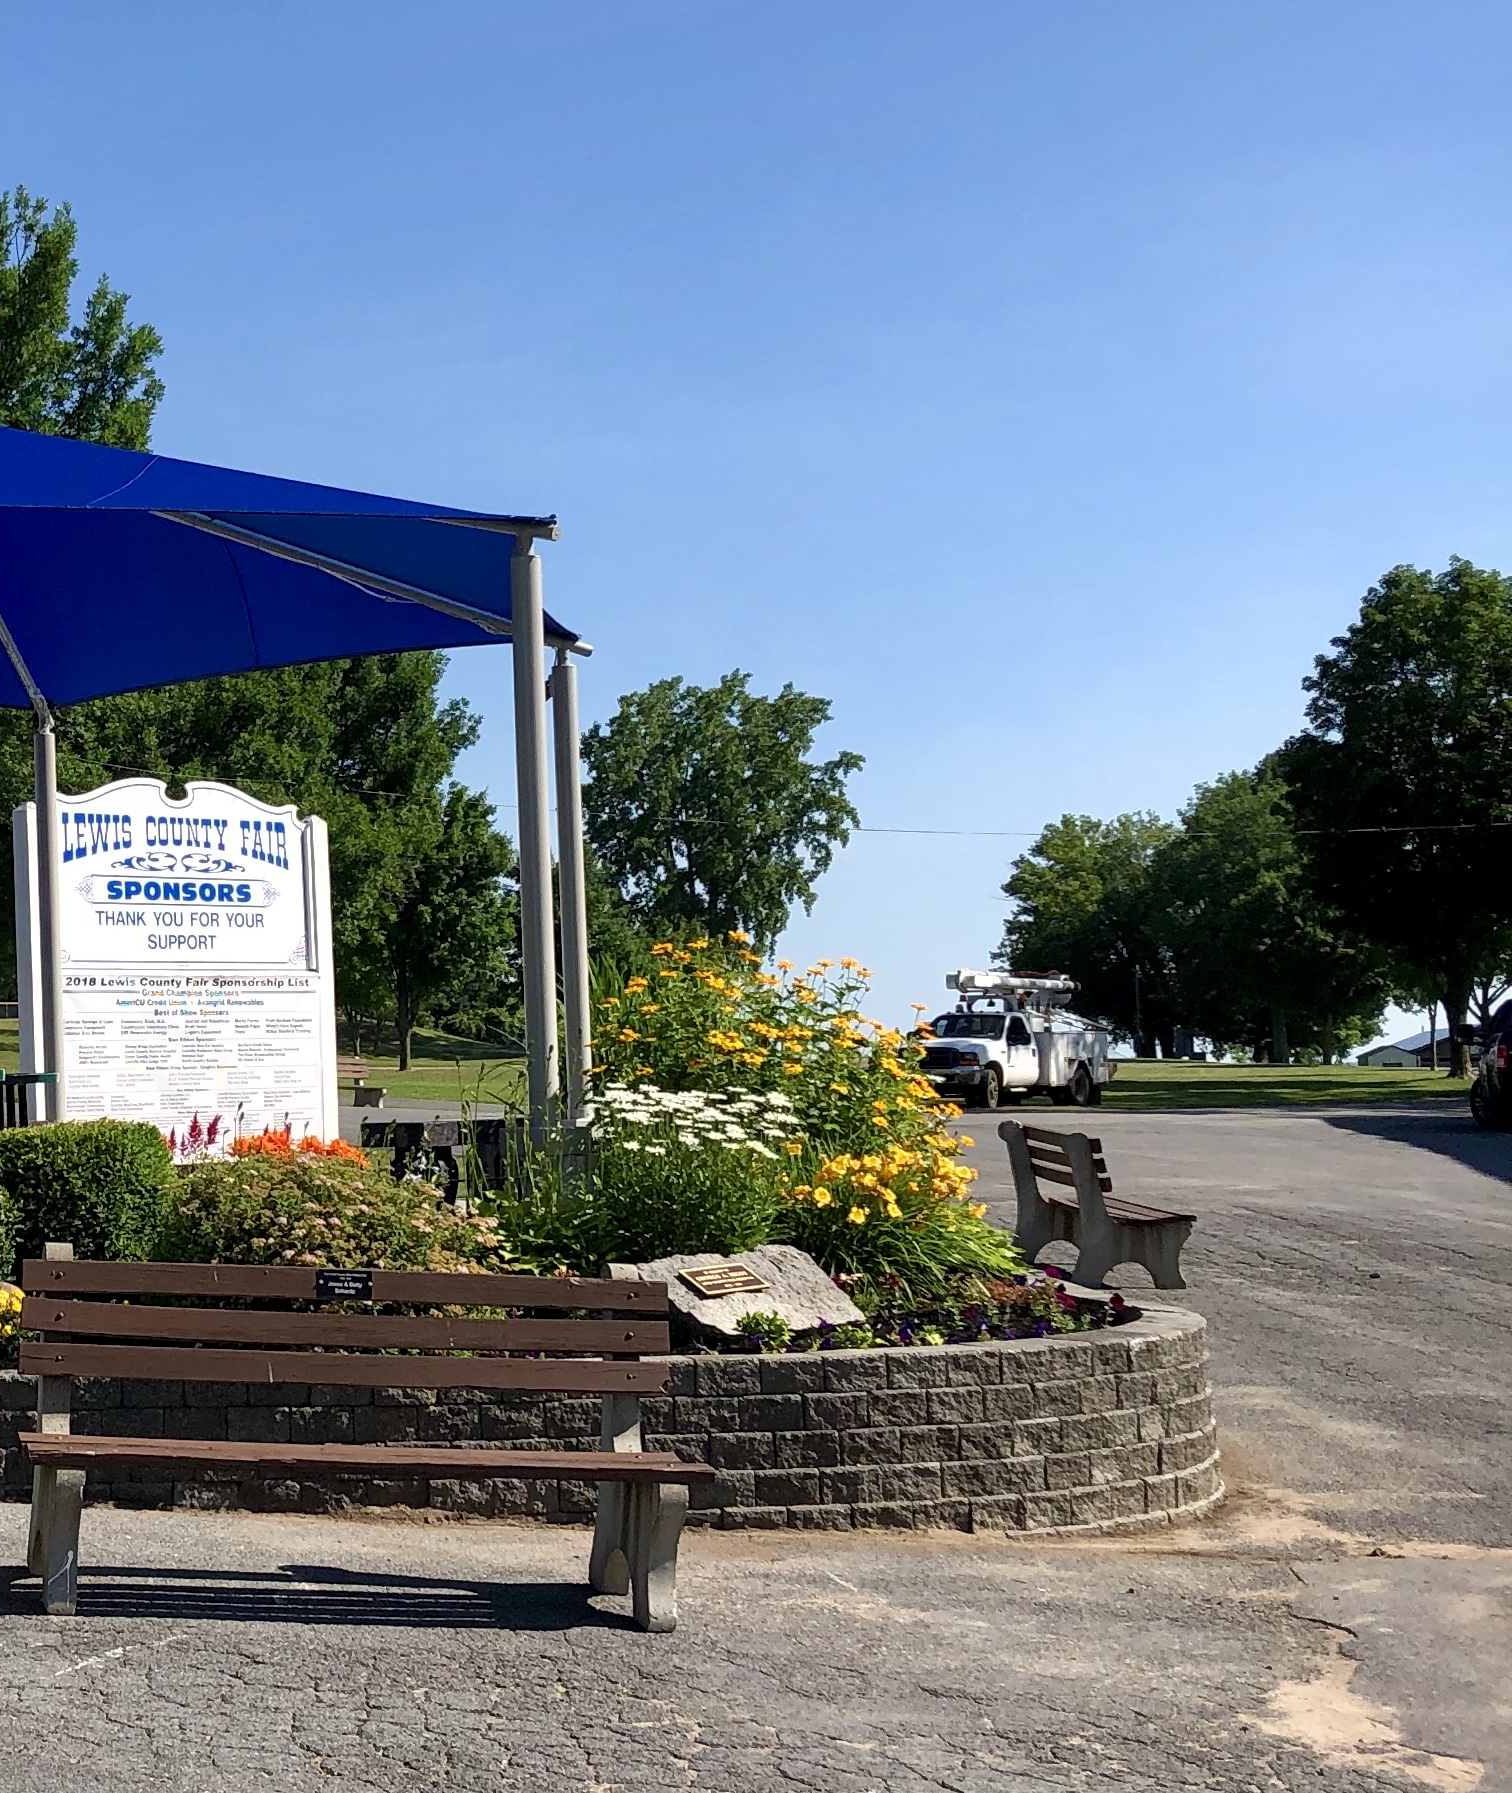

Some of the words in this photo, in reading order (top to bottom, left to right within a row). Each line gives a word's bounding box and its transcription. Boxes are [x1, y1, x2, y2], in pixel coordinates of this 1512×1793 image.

[62, 812, 132, 863] LEWIS
[146, 815, 227, 851] COUNTY
[240, 820, 289, 870] FAIR
[107, 880, 251, 902] SPONSORS
[95, 910, 147, 926] THANK
[153, 911, 183, 927] YOU
[190, 912, 219, 927] FOR
[226, 912, 265, 928] YOUR
[148, 934, 217, 950] SUPPORT
[65, 977, 97, 987] 2018
[101, 977, 136, 987] Lewis
[140, 977, 182, 988] County
[186, 977, 208, 987] Fair
[211, 977, 284, 988] Sponsorship
[288, 978, 310, 987] List
[205, 989, 239, 998] Sponsors
[200, 1009, 229, 1017] Sponsors
